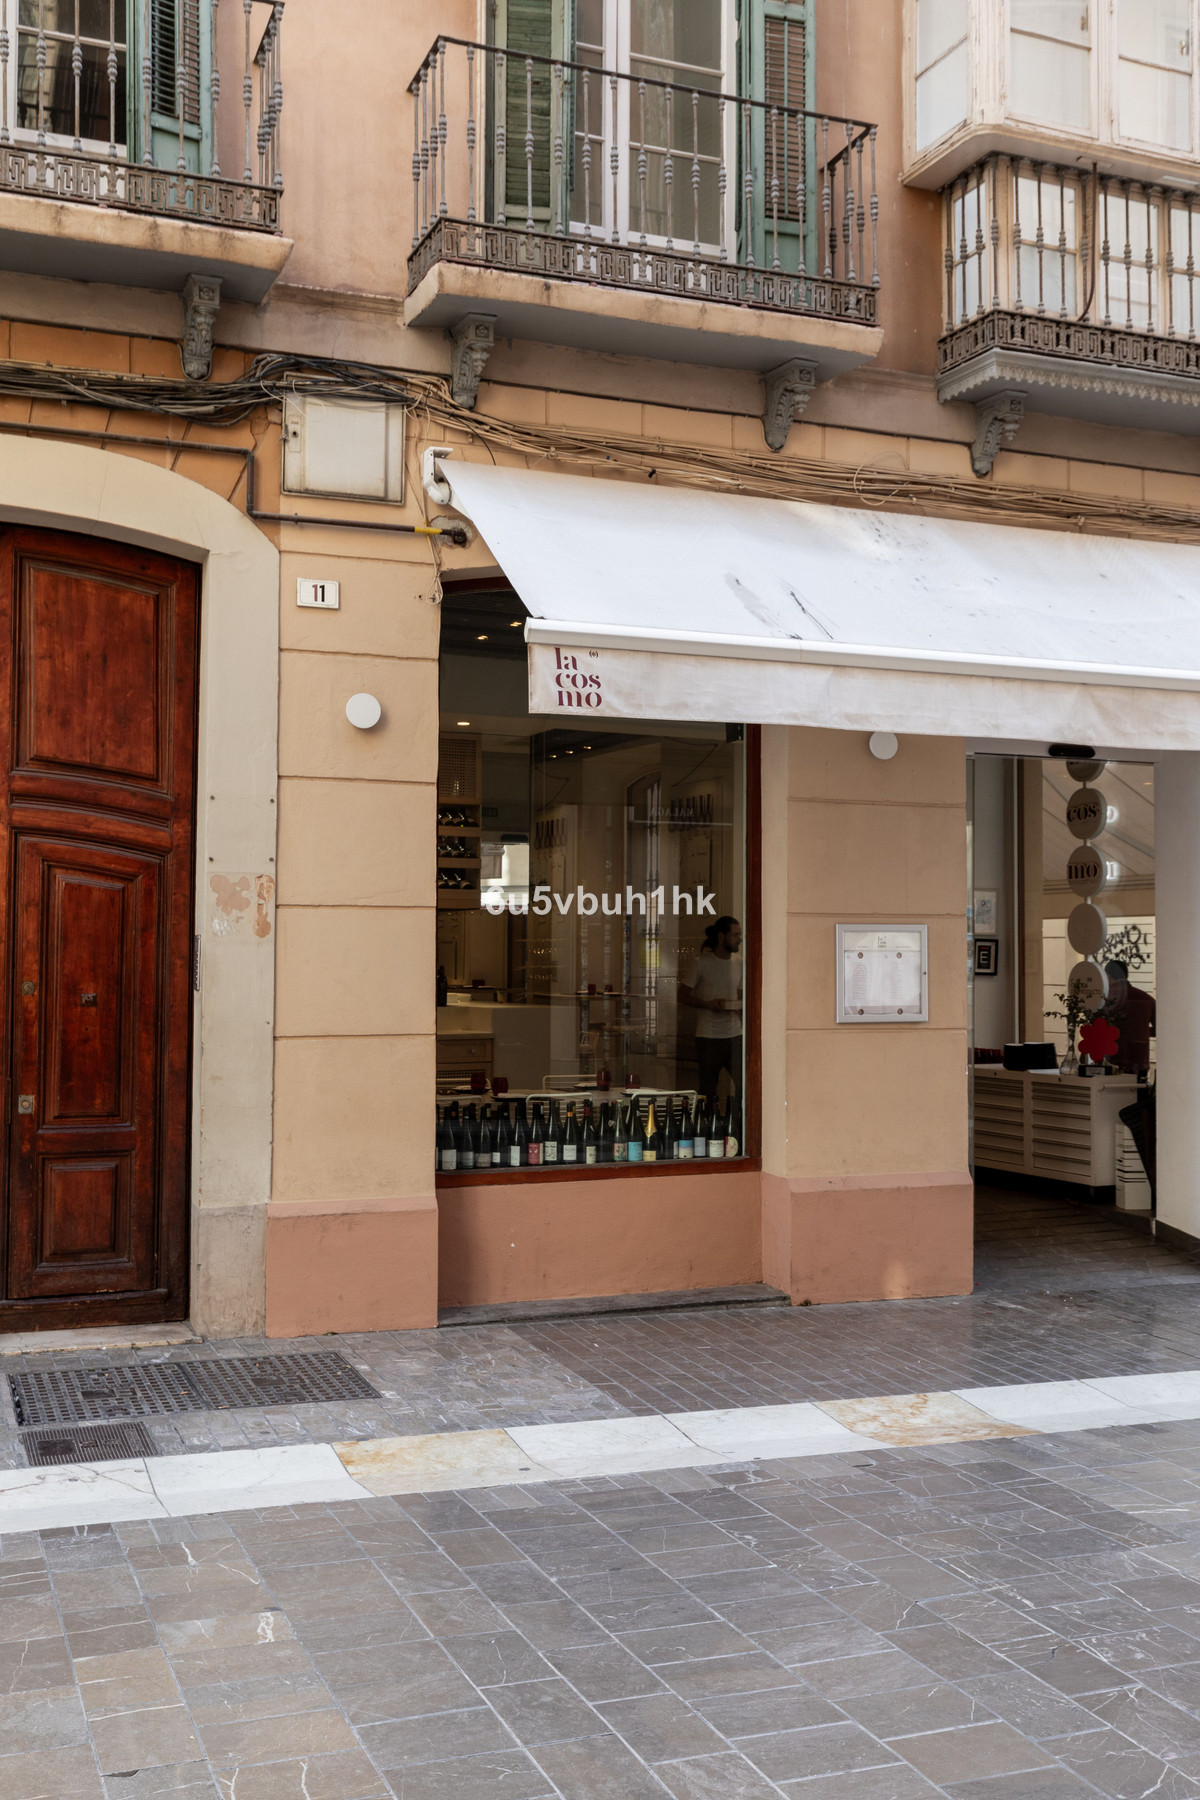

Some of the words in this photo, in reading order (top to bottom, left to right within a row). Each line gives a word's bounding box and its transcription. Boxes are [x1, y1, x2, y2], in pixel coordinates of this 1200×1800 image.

[312, 584, 325, 602] 11
[555, 647, 578, 670] la
[555, 673, 602, 689] cos
[557, 690, 602, 708] mo
[1067, 804, 1097, 822] cos
[1068, 864, 1098, 880] mo
